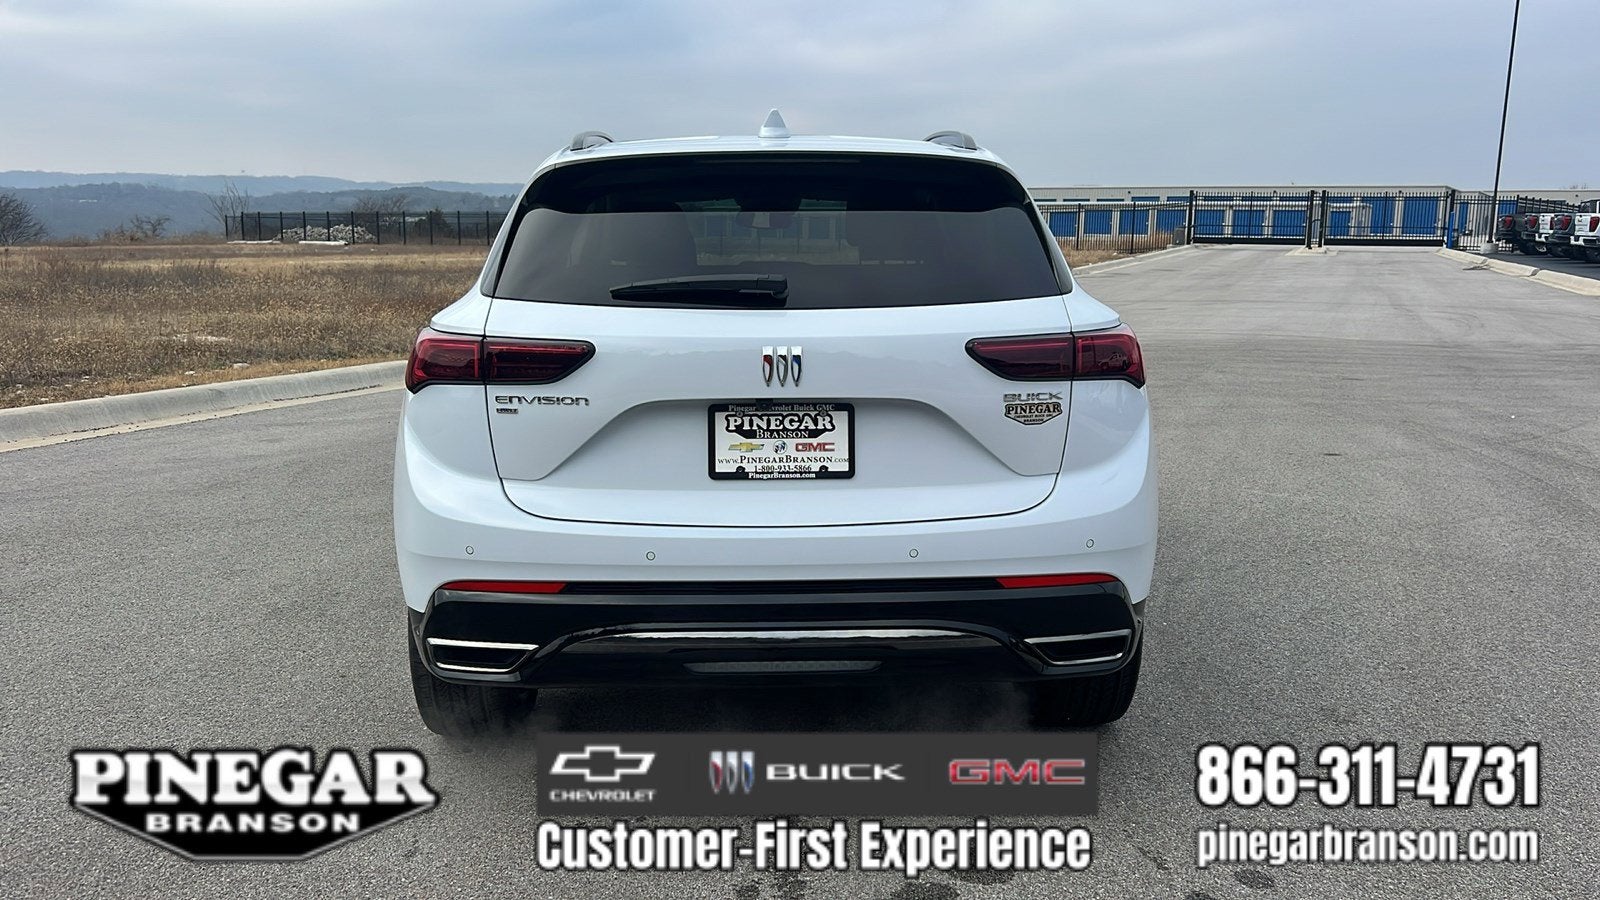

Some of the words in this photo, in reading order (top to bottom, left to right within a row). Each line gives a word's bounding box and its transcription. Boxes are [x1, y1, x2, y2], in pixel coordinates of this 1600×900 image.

[495, 395, 590, 406] ENVISION
[1003, 391, 1063, 402] BUICK
[728, 404, 757, 413] Pinegar
[1007, 403, 1060, 415] PINEGAR
[728, 416, 833, 431] PINEGAR
[756, 430, 809, 439] BRANSON
[795, 442, 836, 453] GMC
[748, 472, 816, 480] PinegarBranson.com
